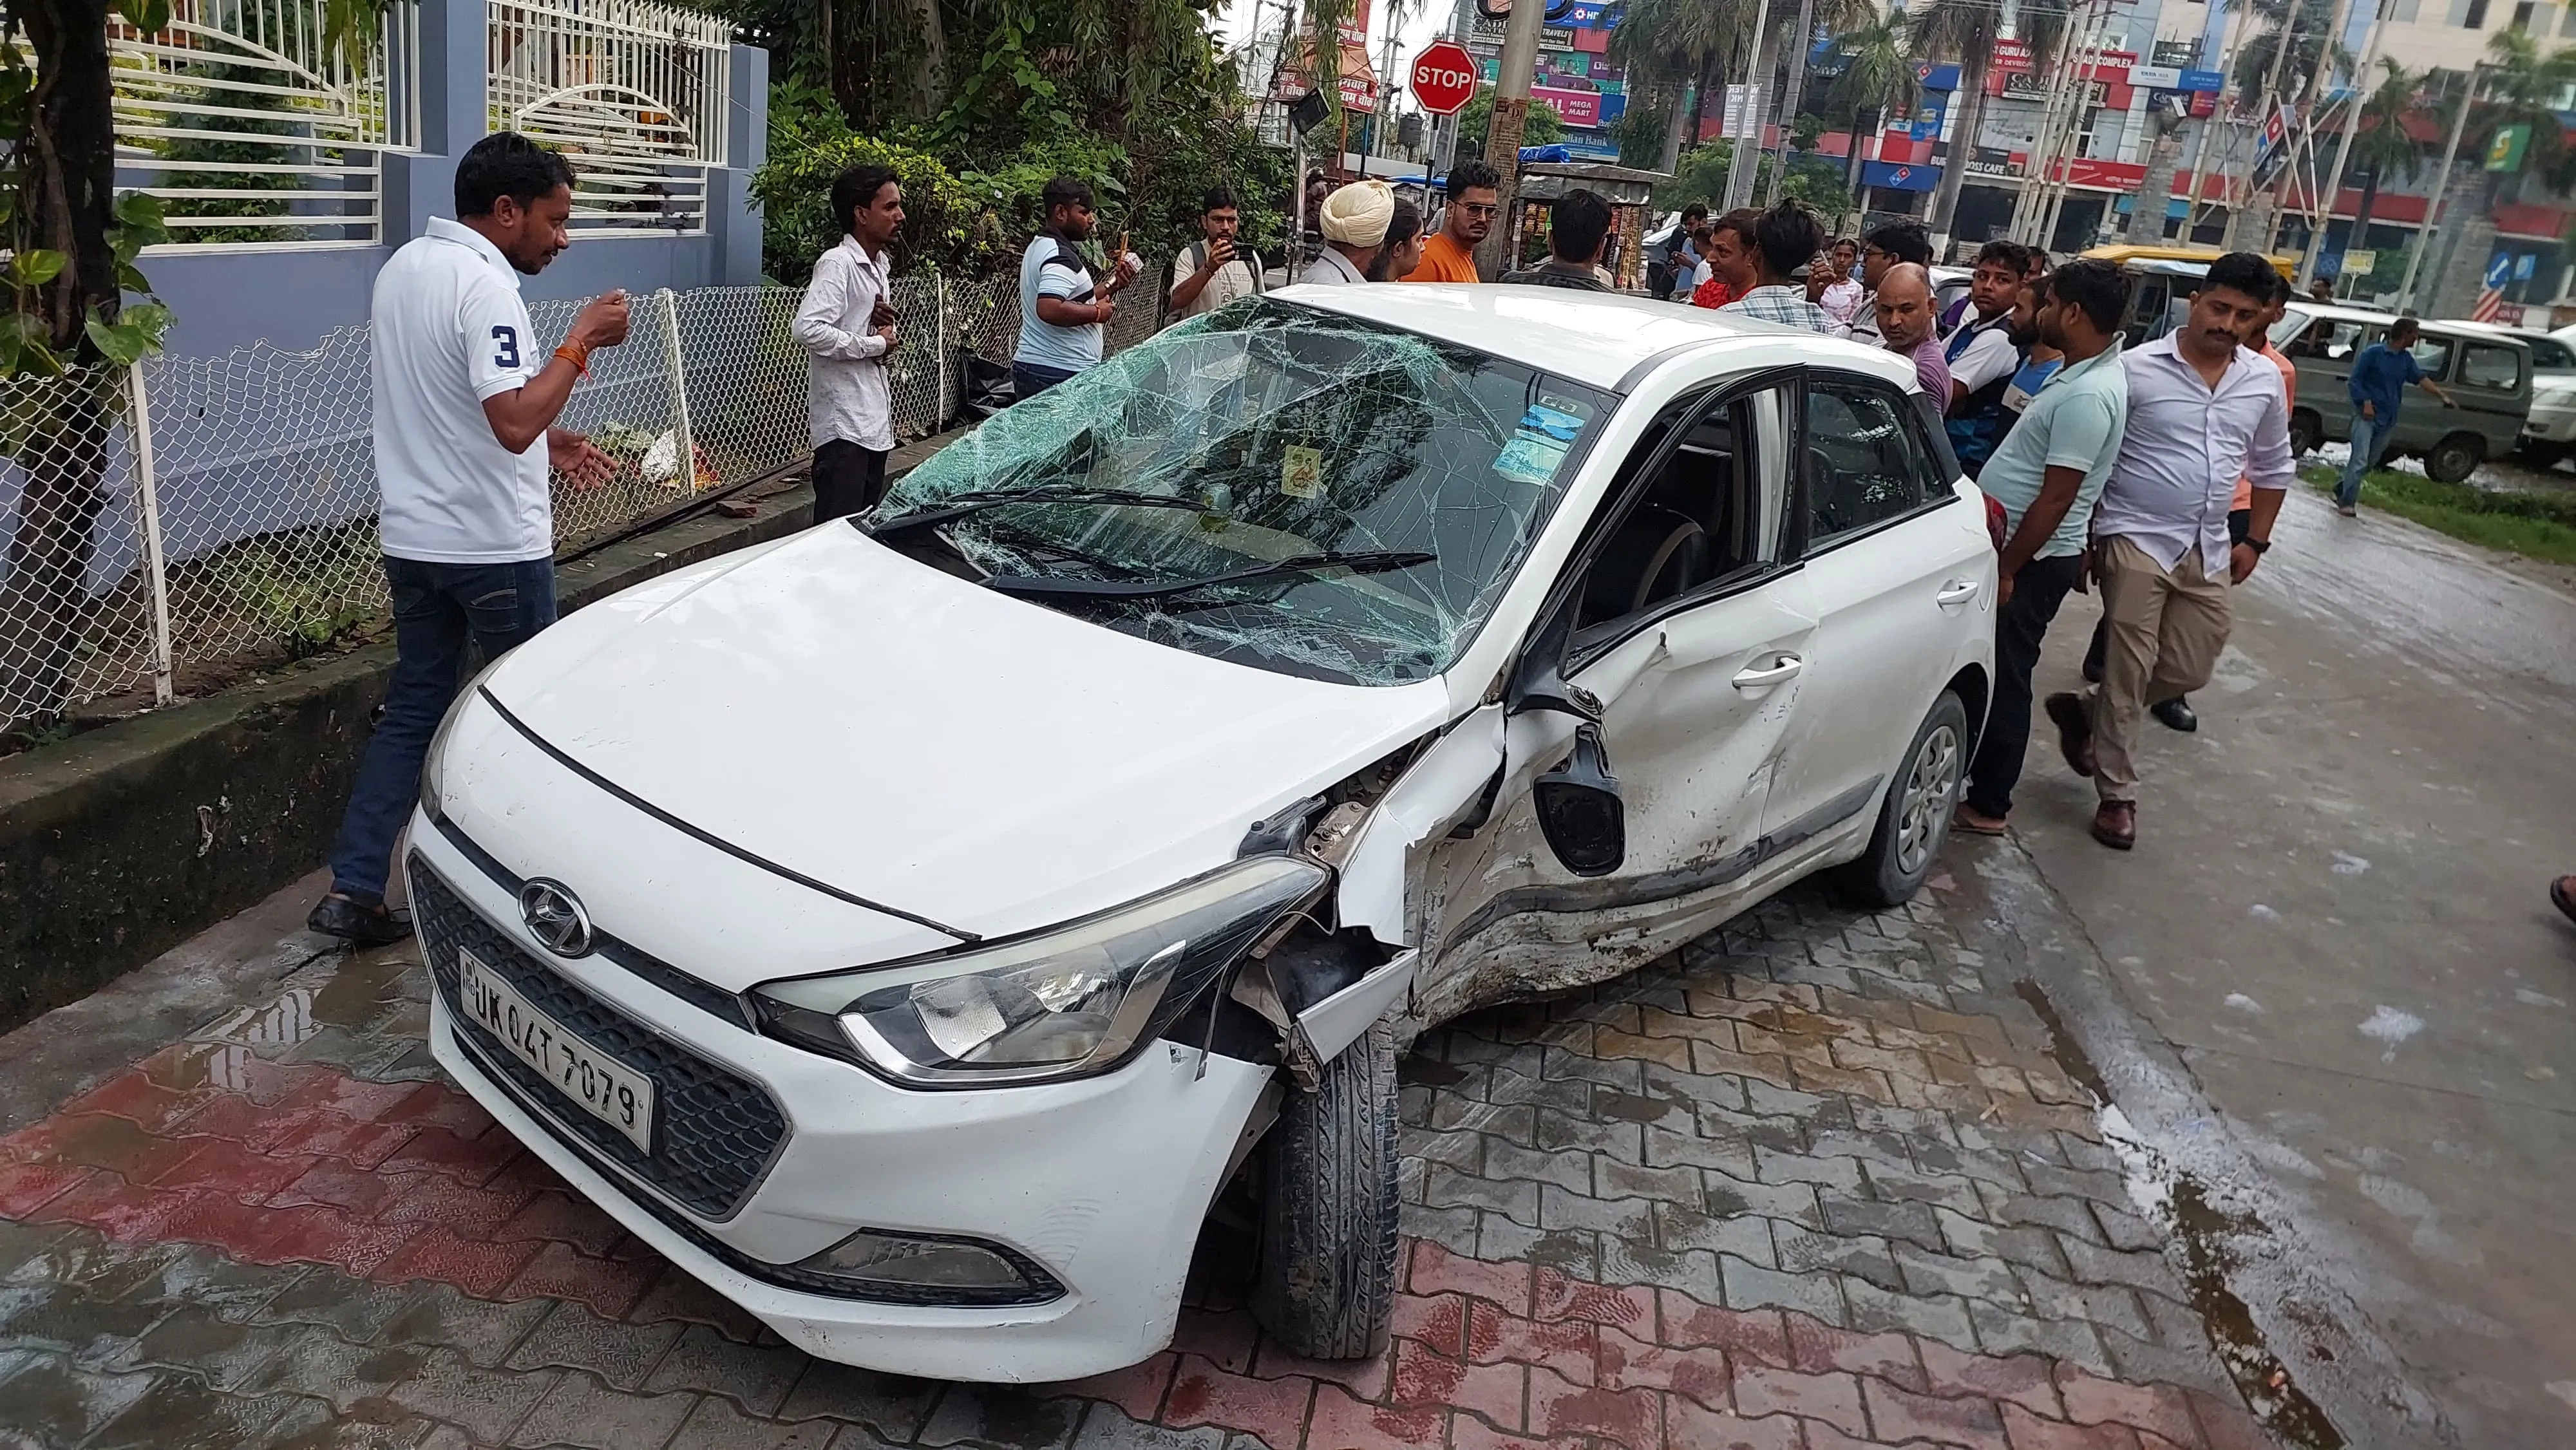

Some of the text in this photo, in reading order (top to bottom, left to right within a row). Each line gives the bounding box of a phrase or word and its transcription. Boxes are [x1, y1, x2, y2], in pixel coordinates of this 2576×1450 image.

[1472, 25, 1508, 34] CENTR
[1542, 28, 1569, 37] TRAVELS
[1999, 45, 2020, 57] GURU
[2098, 56, 2132, 68] COMPLEX
[1417, 66, 1471, 89] STOP
[1569, 100, 1592, 109] MEGA
[1568, 108, 1591, 117] MART
[1560, 133, 1608, 147] ndian Bank
[1984, 162, 2005, 174] CAFE
[491, 325, 520, 368] 3
[462, 977, 475, 997] IND
[560, 1042, 635, 1130] 7079
